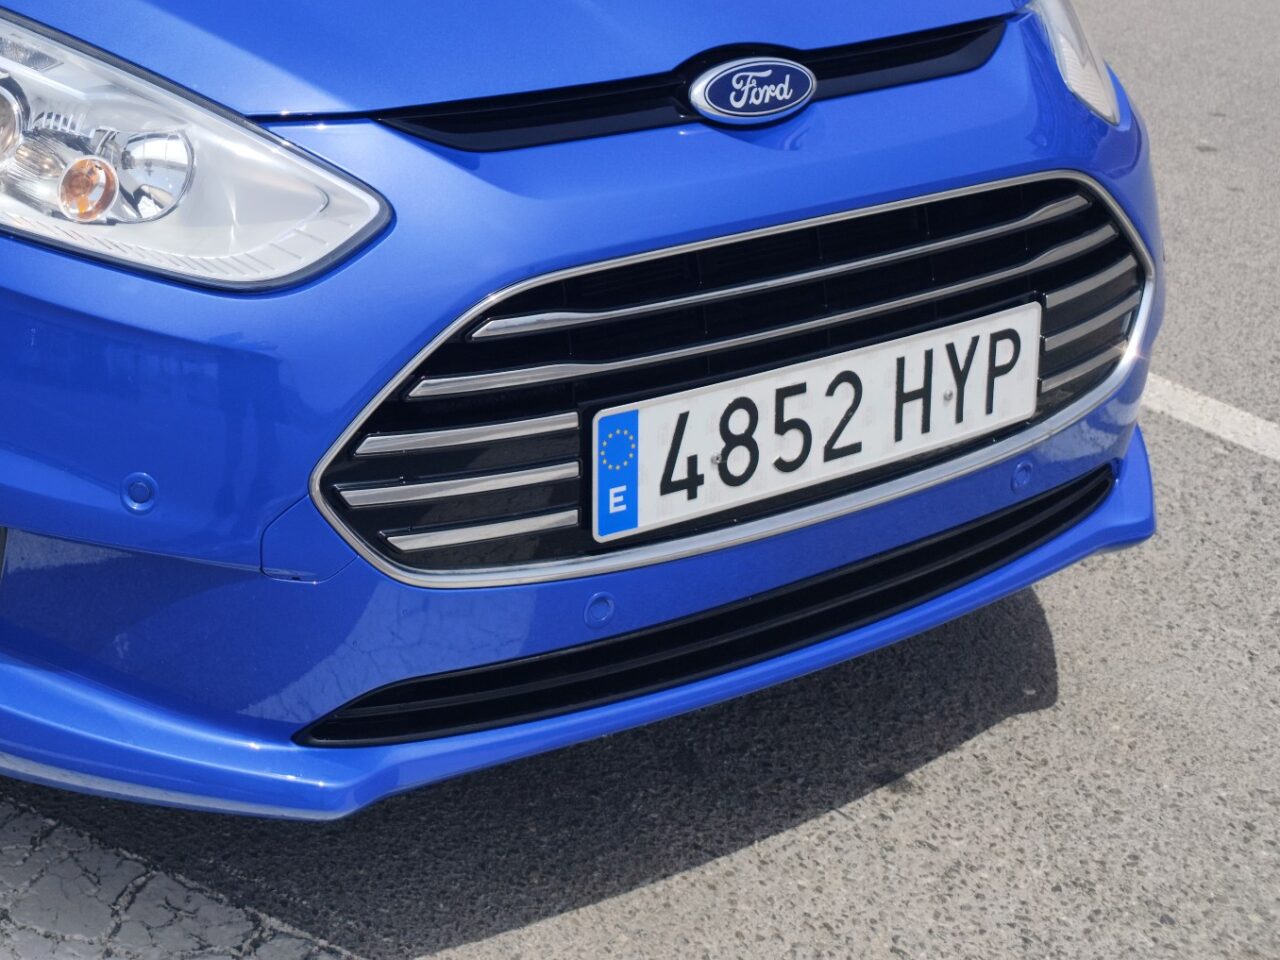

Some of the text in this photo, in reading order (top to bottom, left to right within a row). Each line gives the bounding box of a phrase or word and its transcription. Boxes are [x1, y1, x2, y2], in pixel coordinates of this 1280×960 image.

[730, 69, 793, 109] Ford
[658, 327, 1022, 502] 4852 HYP
[608, 485, 628, 515] E
